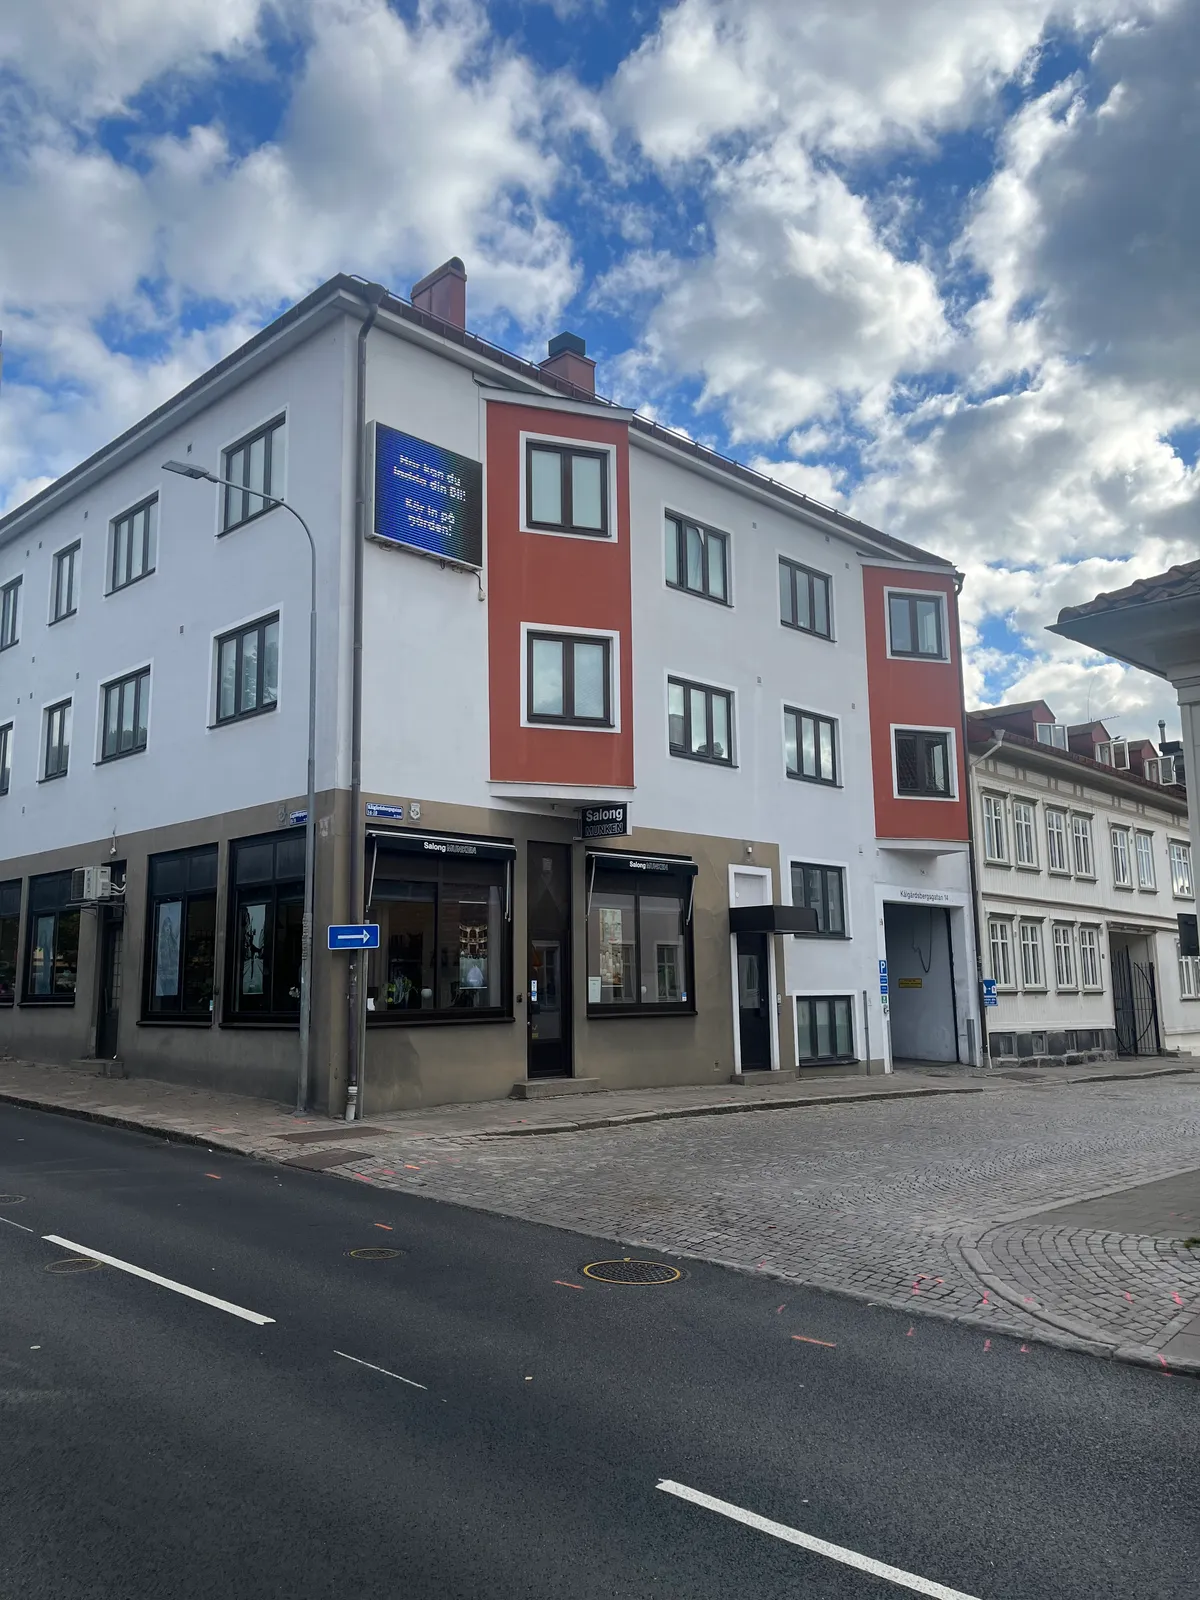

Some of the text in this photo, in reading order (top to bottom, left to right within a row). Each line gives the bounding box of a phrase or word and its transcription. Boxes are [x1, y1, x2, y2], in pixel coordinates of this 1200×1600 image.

[423, 463, 444, 480] kan
[446, 473, 461, 487] du
[429, 480, 447, 495] din
[427, 505, 438, 518] in
[586, 808, 623, 821] Salong
[585, 822, 623, 836] MUNKEN
[423, 841, 446, 852] Salong
[629, 861, 646, 870] Salong
[880, 961, 886, 974] P
